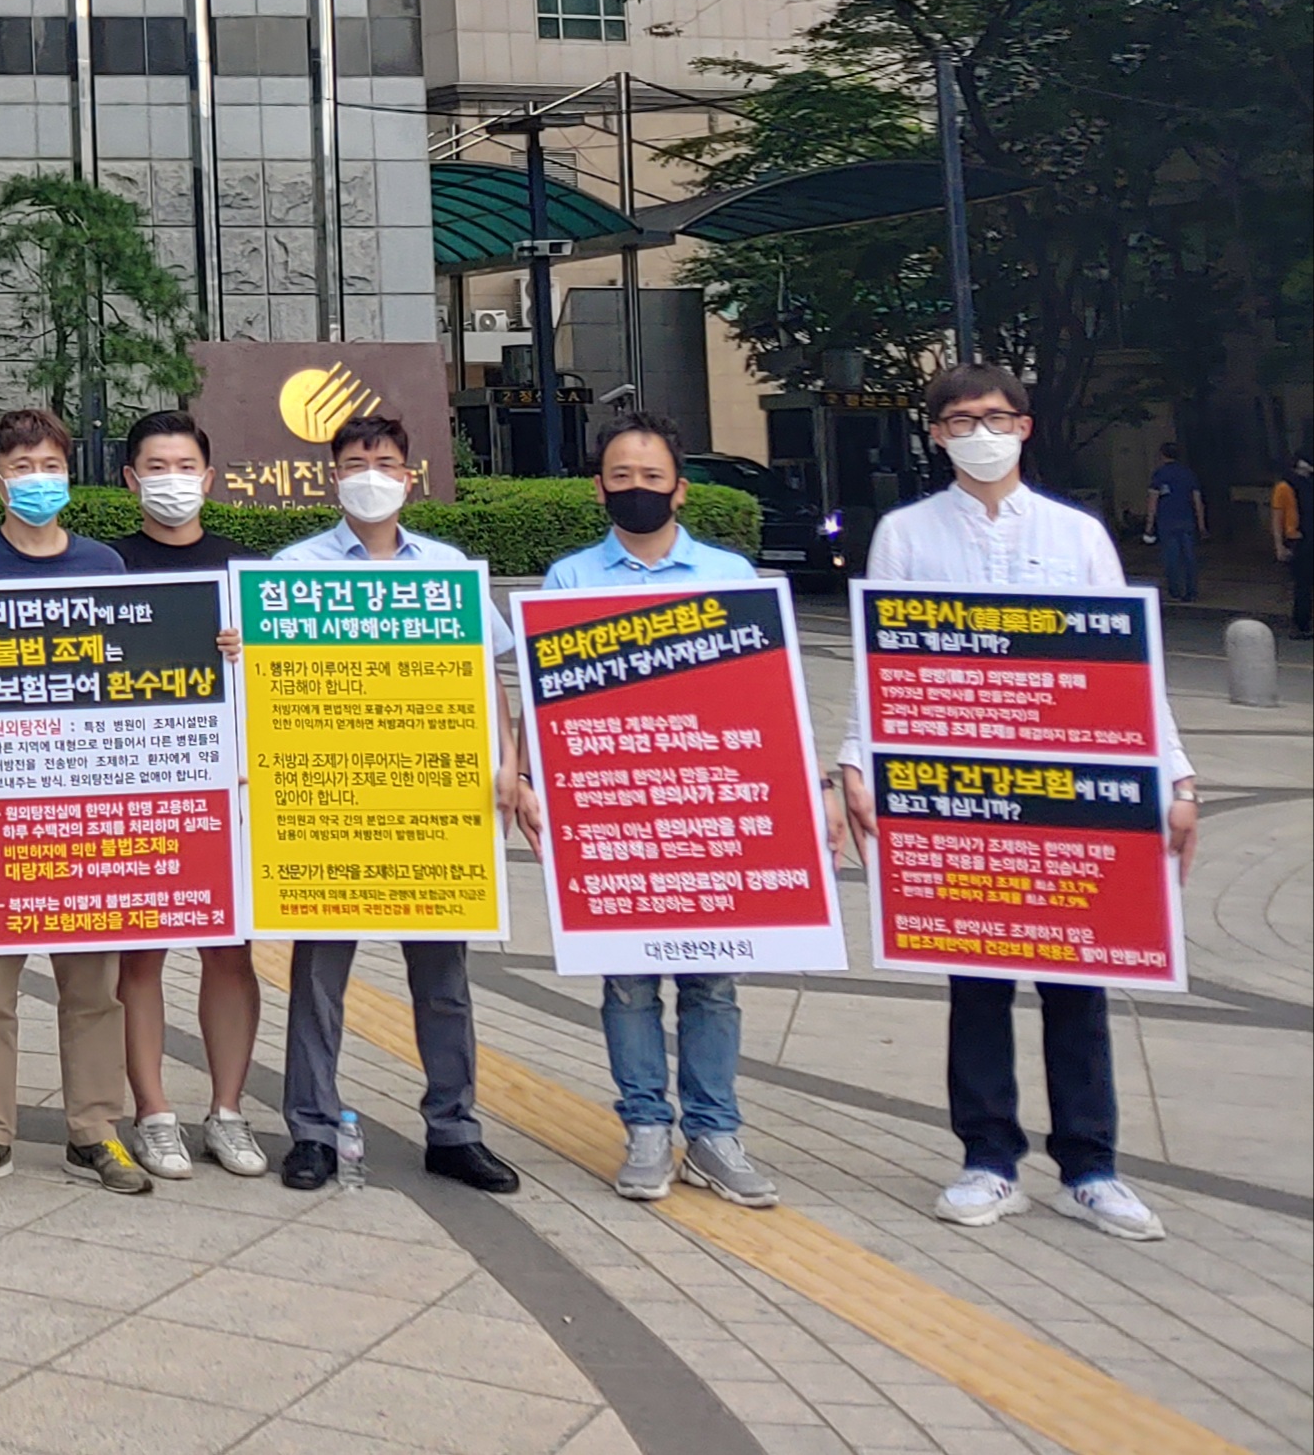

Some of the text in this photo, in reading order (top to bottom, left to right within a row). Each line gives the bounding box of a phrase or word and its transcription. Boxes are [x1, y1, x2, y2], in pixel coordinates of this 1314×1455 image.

[118, 604, 153, 624] 의한
[1090, 612, 1131, 635] 대해
[260, 617, 466, 639] 이렇게 시행해야 합니다.
[876, 629, 1011, 654] 알고 계십니까?
[51, 634, 123, 664] 조제는
[539, 623, 770, 699] 한약사가 당사자입니다.
[107, 667, 215, 700] 환수대상
[885, 760, 1140, 804] 첩약 건강보험에 대해
[887, 792, 1022, 821] 알고 계십니까?
[644, 939, 754, 962] 대한한약사회
